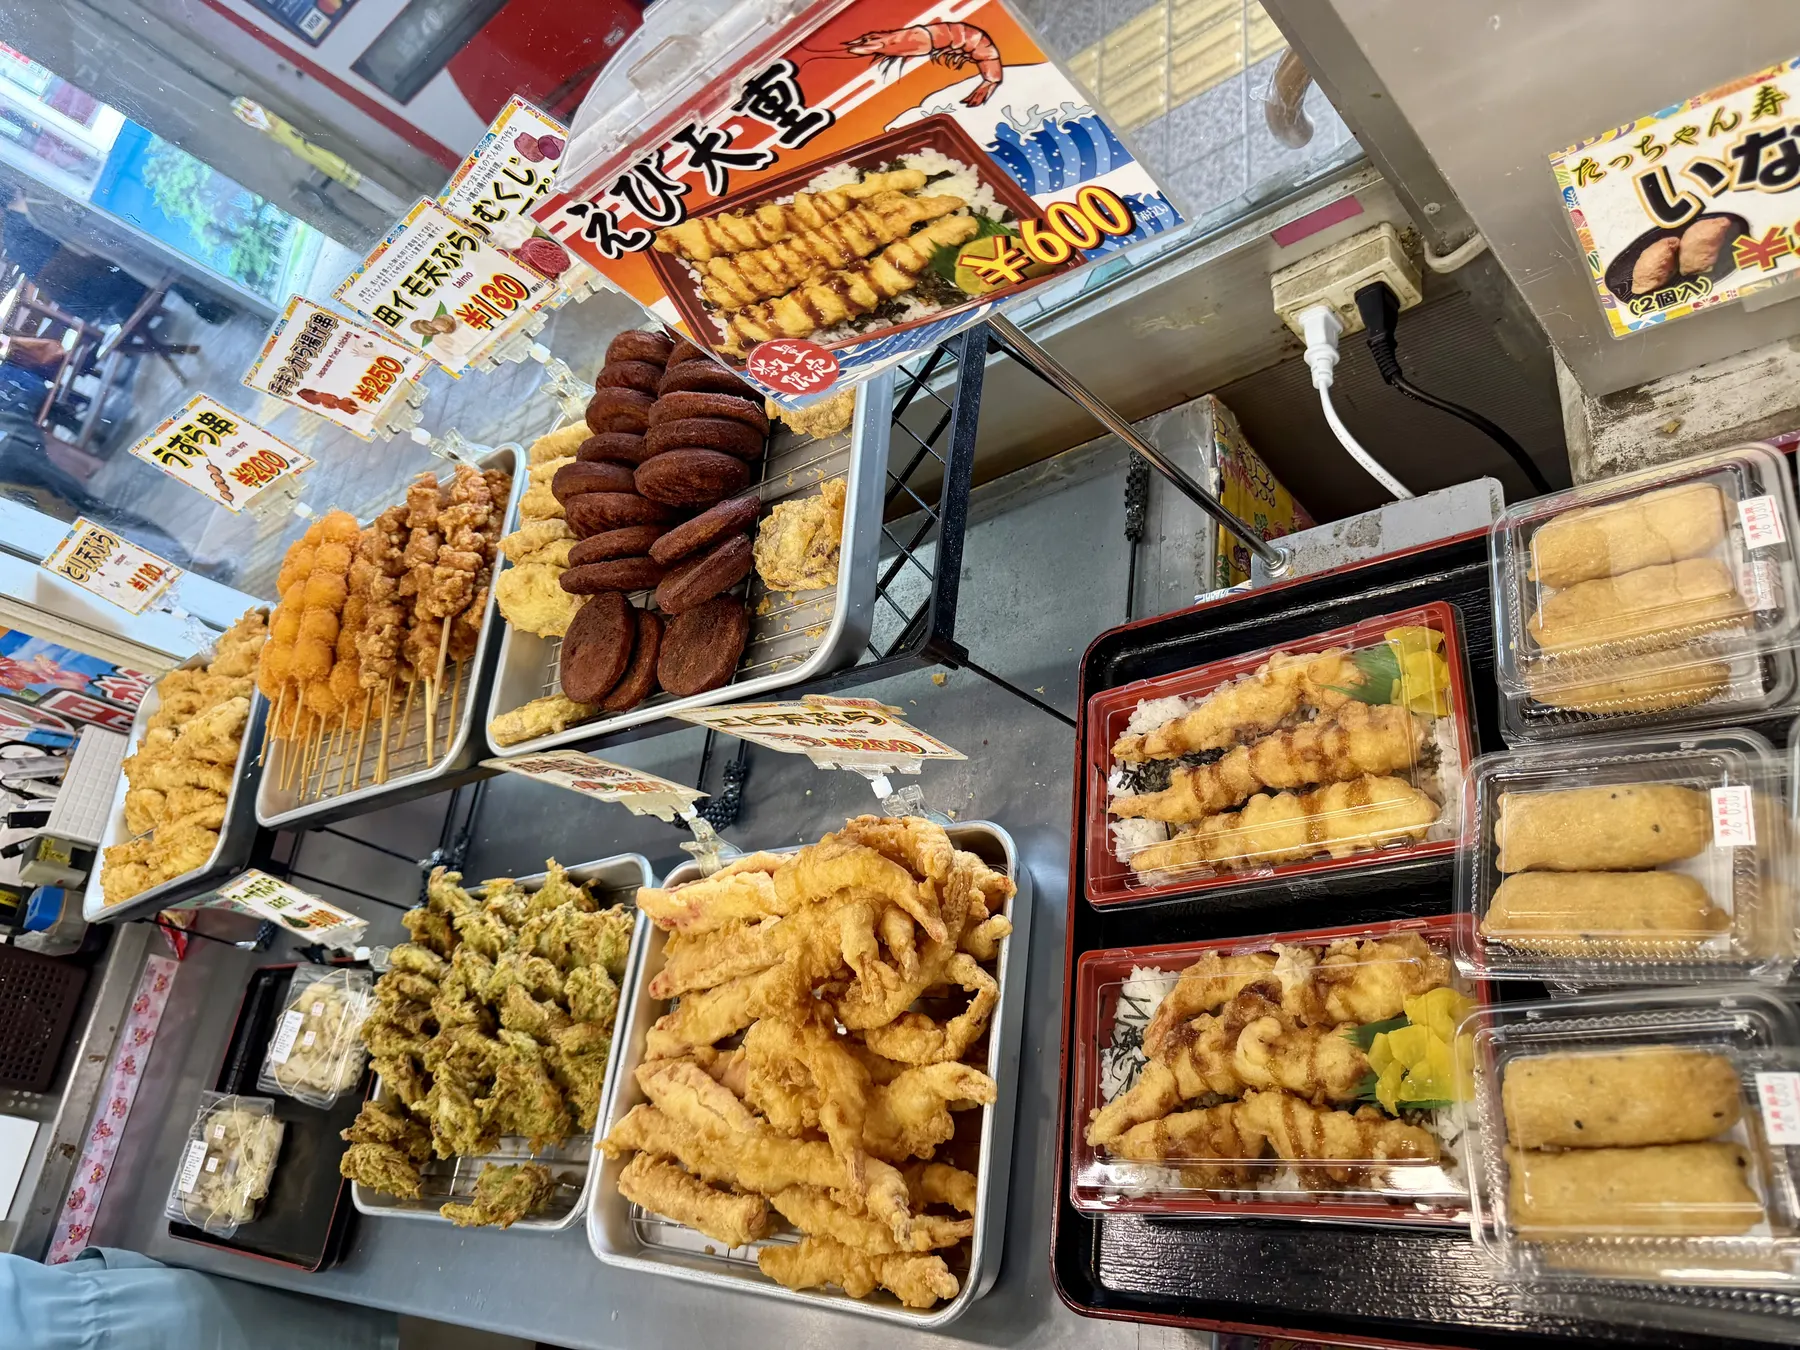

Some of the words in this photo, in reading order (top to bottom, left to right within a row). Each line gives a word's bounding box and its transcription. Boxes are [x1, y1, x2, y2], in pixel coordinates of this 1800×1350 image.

[566, 58, 836, 260] えび天重
[1571, 84, 1791, 189] たっちゃん寿
[958, 184, 1138, 287] ¥600
[371, 230, 481, 331] 田イモ天ぷら
[451, 270, 475, 290] taimo
[454, 272, 531, 332] ¥130
[1627, 275, 1714, 318] (2個入)
[268, 312, 340, 398] チキンから揚げ串
[315, 357, 335, 380] Japanese
[336, 330, 354, 351] chicken
[351, 355, 405, 404] ¥250
[780, 358, 837, 391] 限定
[152, 412, 239, 469] うずら串
[229, 449, 291, 489] ¥200
[704, 709, 888, 728] エビ天ぷら
[820, 737, 927, 755] ¥200
